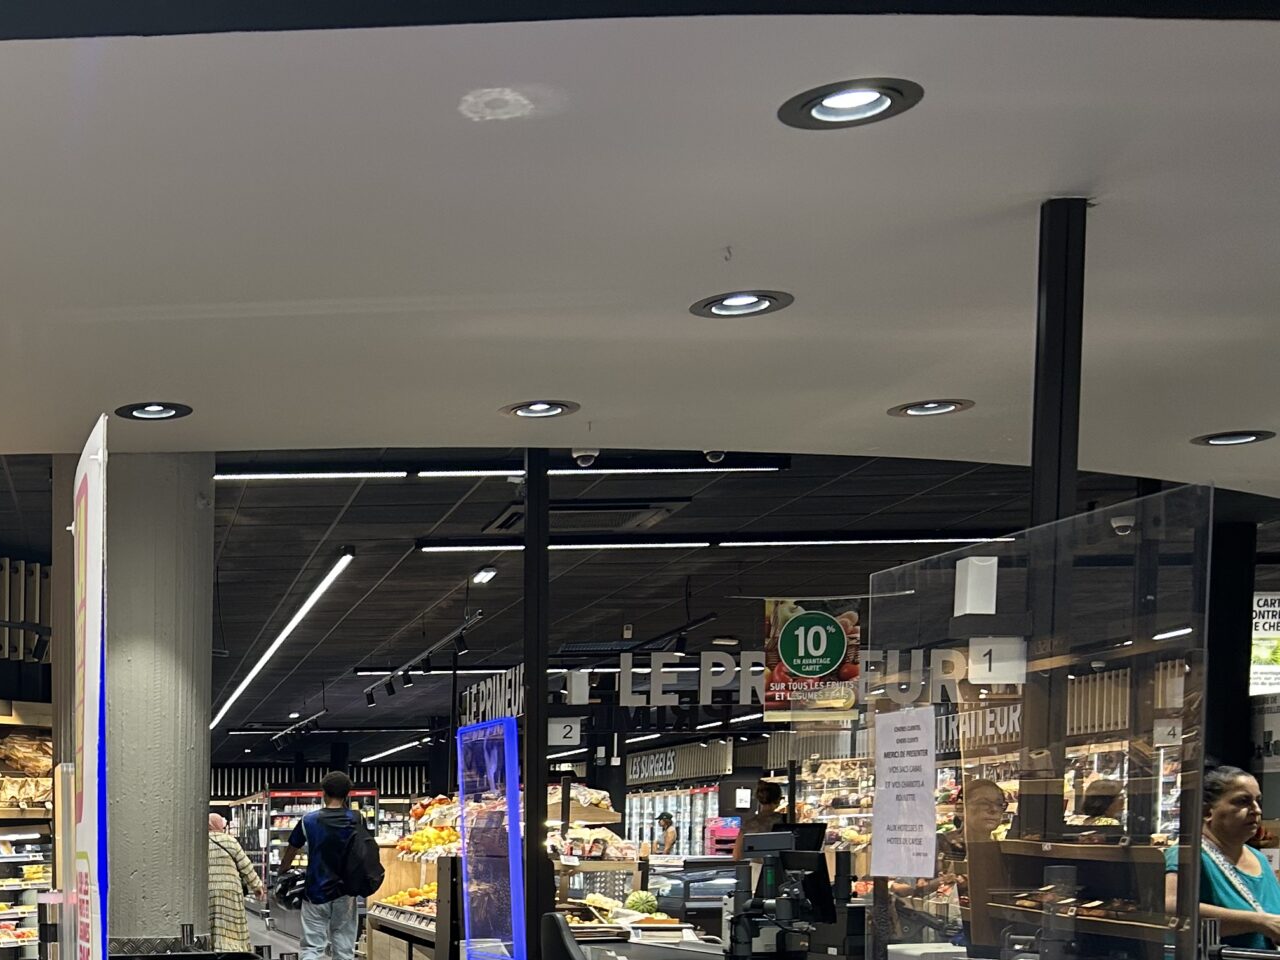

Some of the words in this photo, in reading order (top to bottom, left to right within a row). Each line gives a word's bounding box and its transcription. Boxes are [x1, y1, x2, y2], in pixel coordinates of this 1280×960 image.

[1252, 609, 1280, 620] ONTR
[802, 657, 831, 665] AVANTAGE
[983, 648, 993, 673] 1
[620, 651, 680, 706] LE
[770, 683, 787, 691] SUR
[788, 682, 808, 691] TOUS
[810, 682, 825, 690] LES
[775, 692, 785, 700] ET
[562, 724, 573, 739] 2
[1167, 726, 1177, 739] 4
